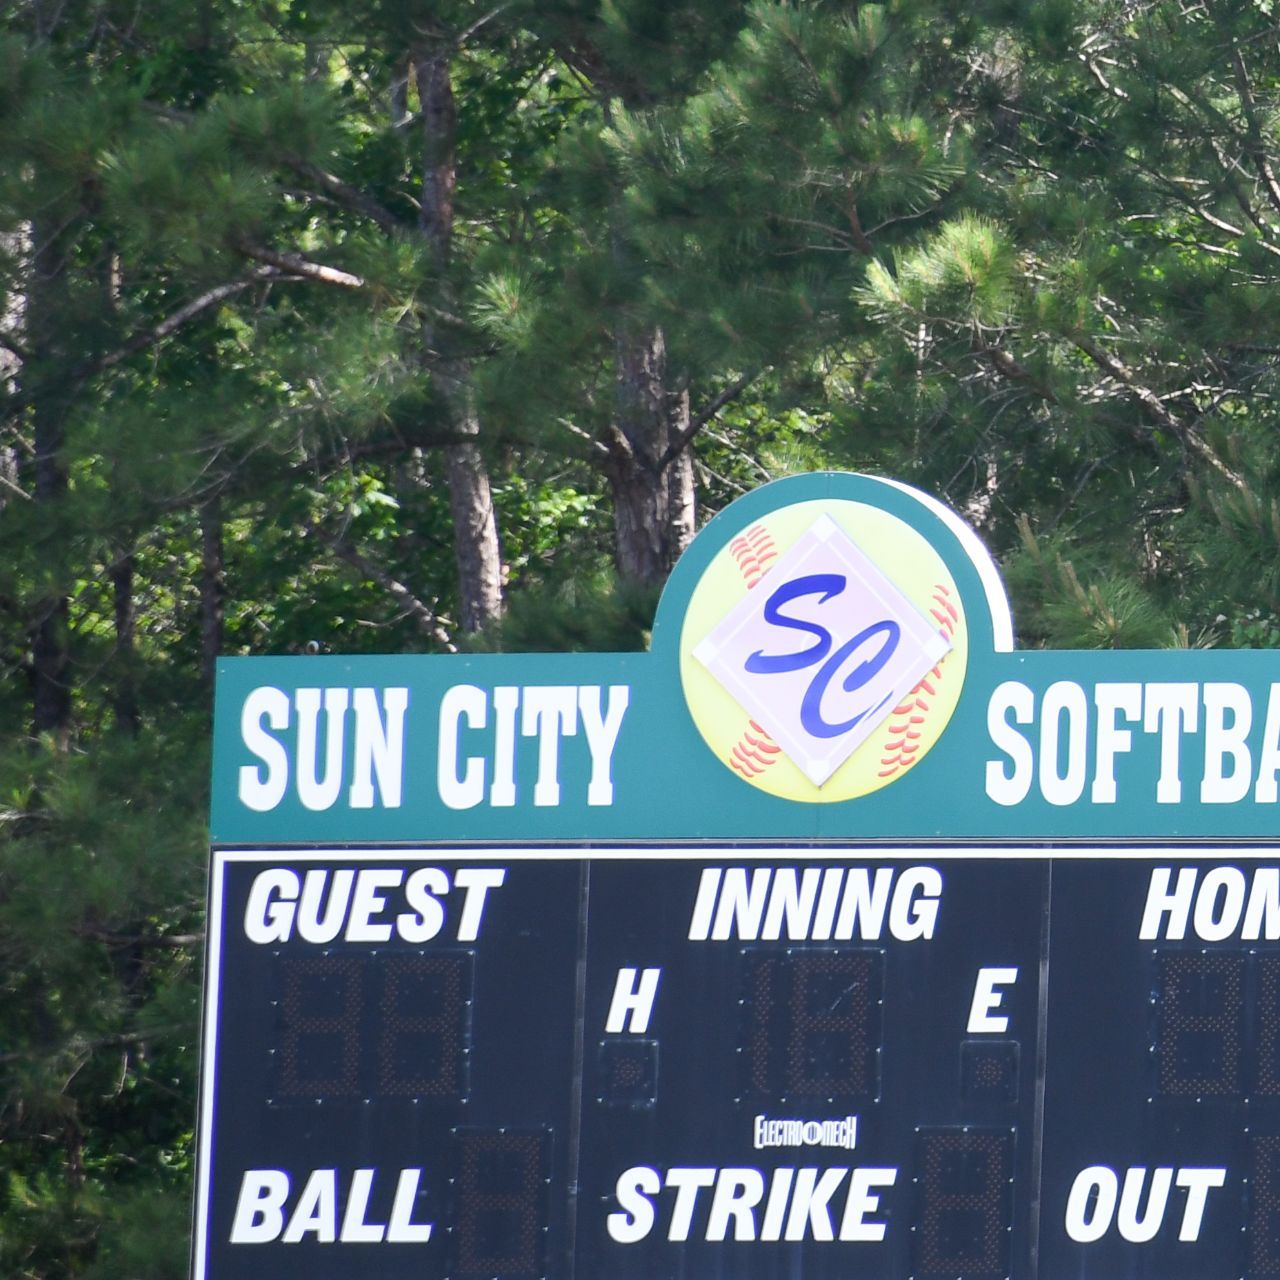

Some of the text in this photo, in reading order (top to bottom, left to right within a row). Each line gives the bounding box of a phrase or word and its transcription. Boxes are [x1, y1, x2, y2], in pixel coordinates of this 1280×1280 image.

[744, 573, 901, 739] SC
[238, 685, 408, 812] SUN
[437, 684, 629, 810] CITY
[244, 867, 505, 944] GUEST
[688, 866, 943, 942] INNING
[605, 968, 660, 1033] H
[967, 967, 1018, 1033] E
[229, 1168, 433, 1244] BALL
[607, 1166, 897, 1244] STRIKE
[1065, 1165, 1227, 1243] OUT
